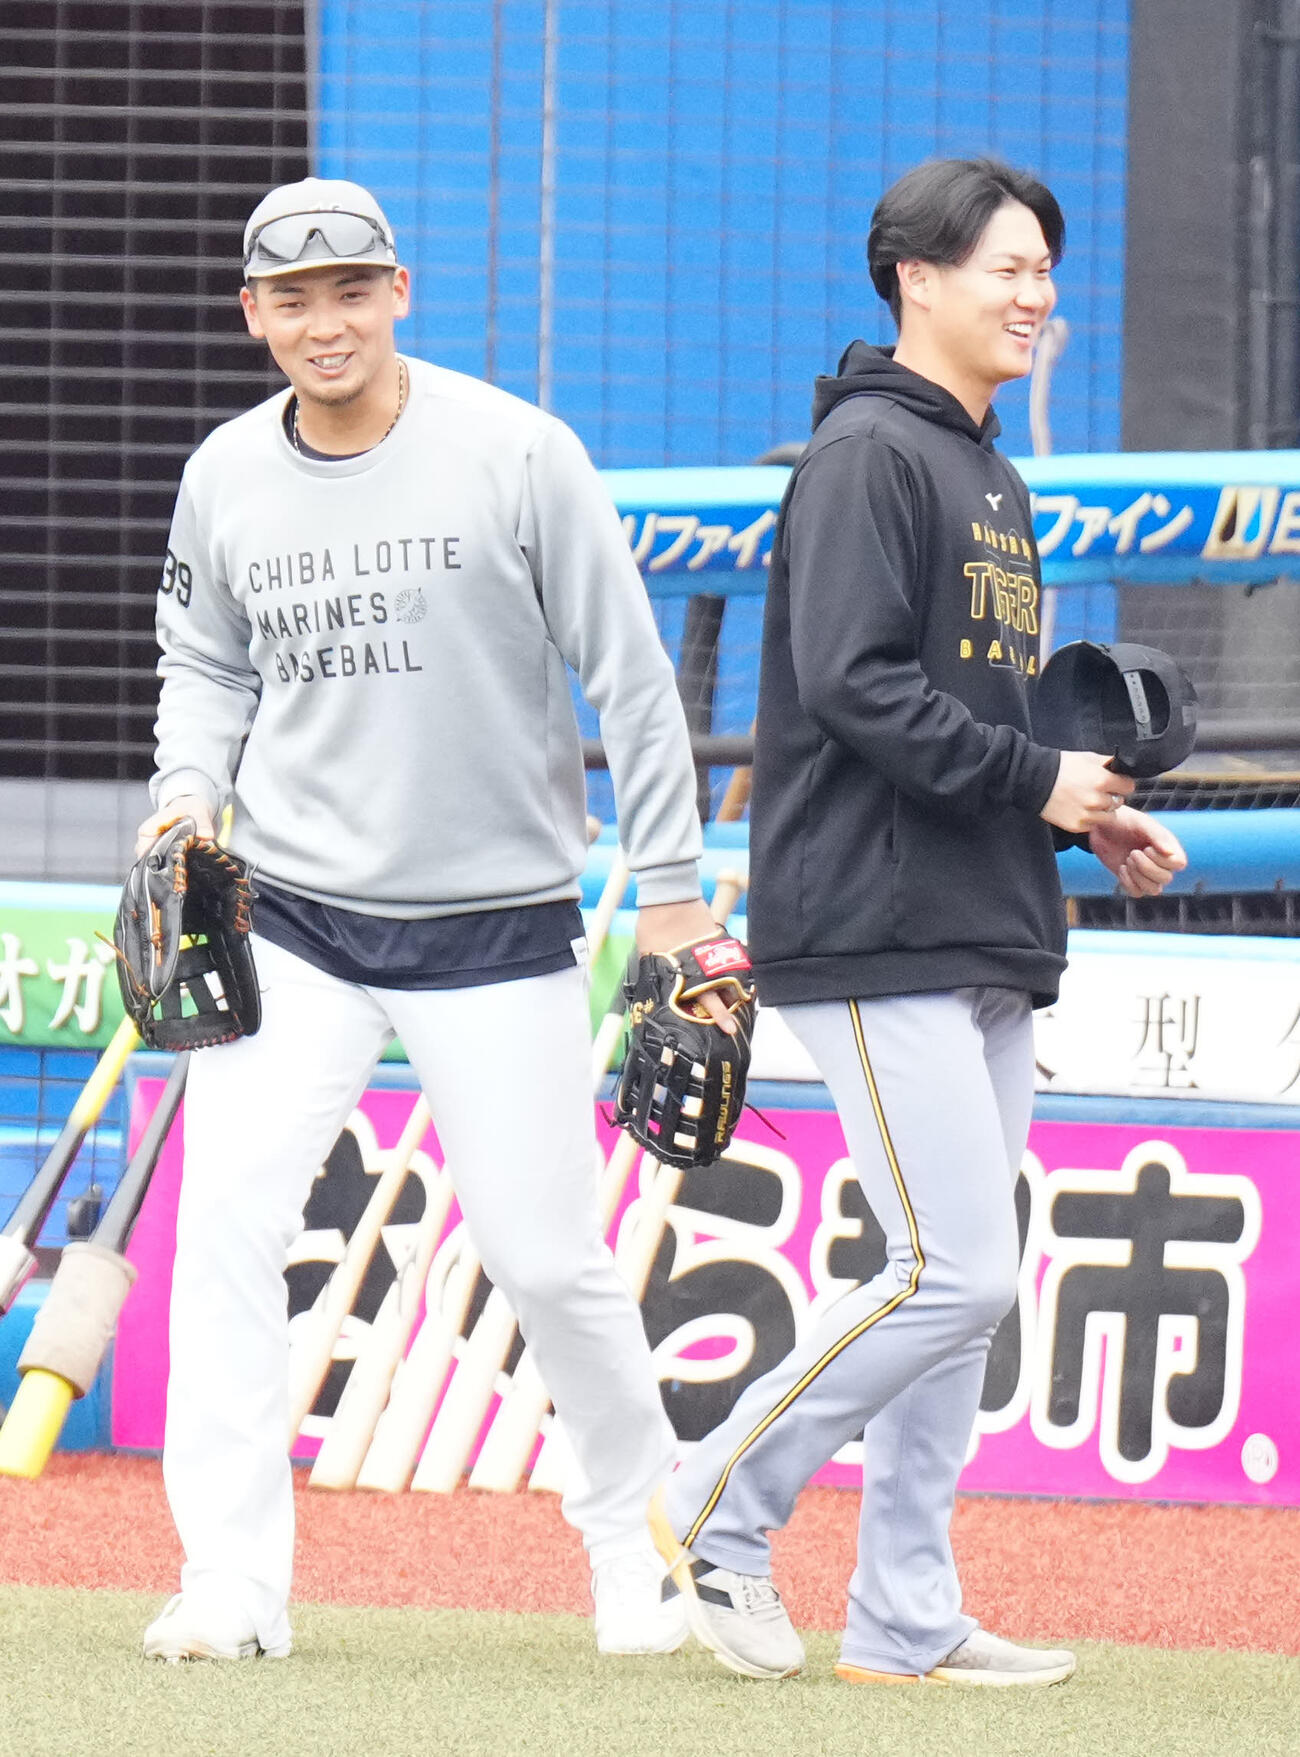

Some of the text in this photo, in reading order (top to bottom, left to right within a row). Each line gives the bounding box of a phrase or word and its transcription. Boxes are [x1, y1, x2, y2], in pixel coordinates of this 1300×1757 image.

[622, 509, 772, 572] リファイ
[1029, 491, 1194, 556] ファイン
[160, 548, 193, 608] 39
[249, 537, 462, 594] CHIBA LOTTE
[256, 592, 388, 640] MARINES
[275, 641, 423, 683] BASEBALL
[714, 1060, 733, 1144] RAWLINGS
